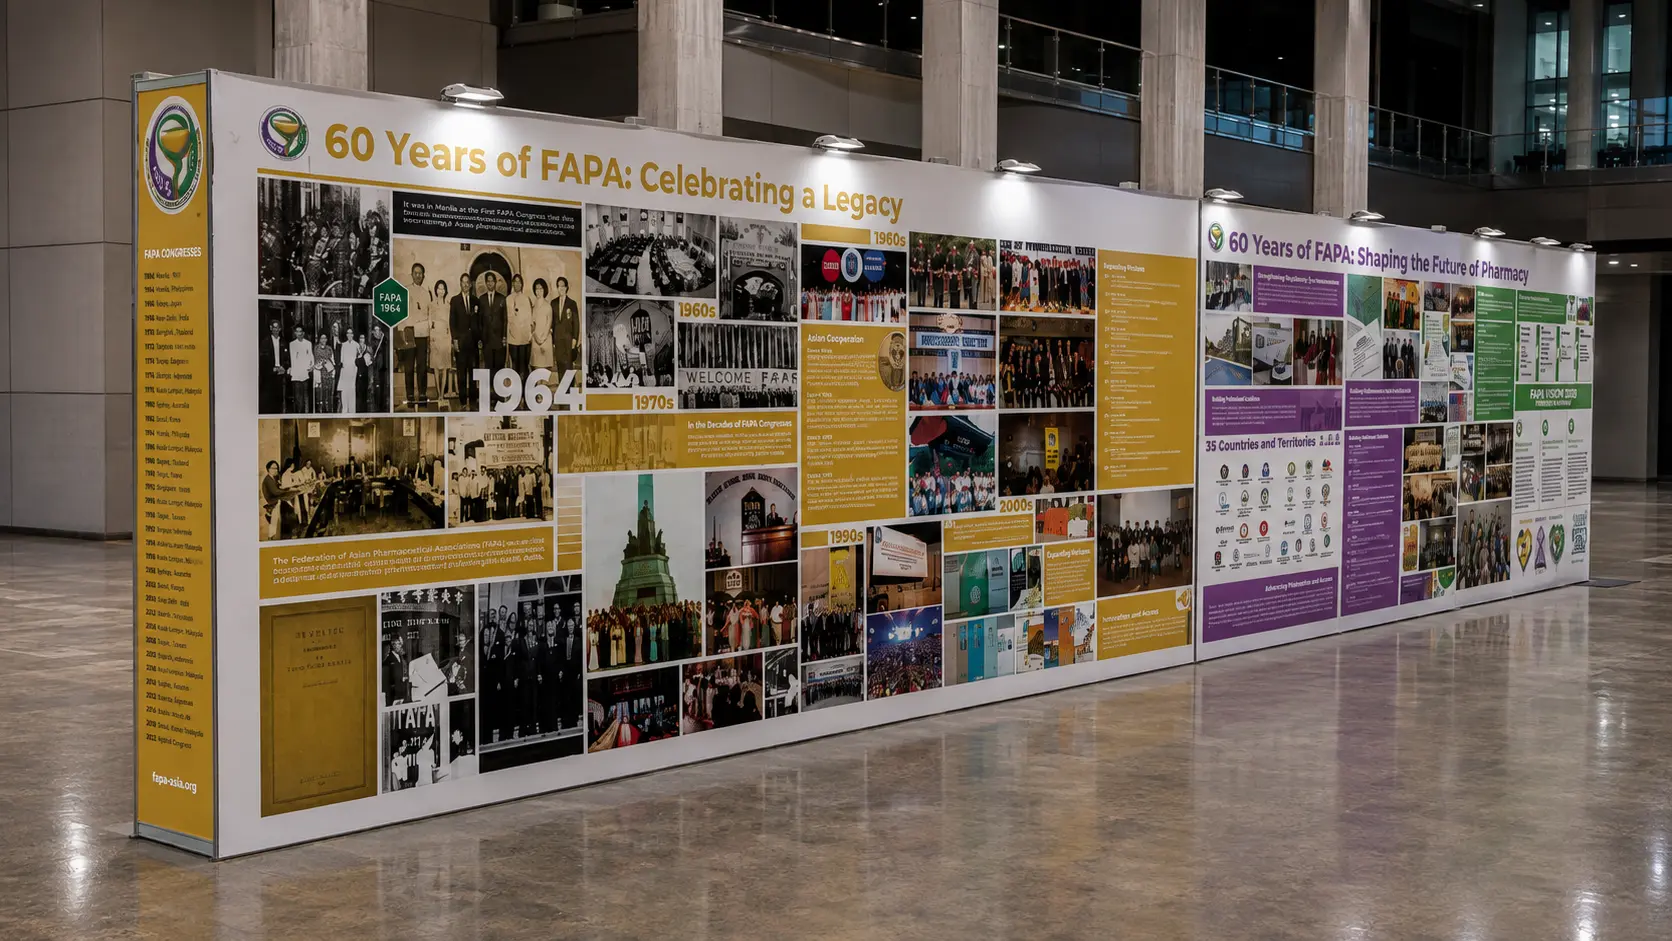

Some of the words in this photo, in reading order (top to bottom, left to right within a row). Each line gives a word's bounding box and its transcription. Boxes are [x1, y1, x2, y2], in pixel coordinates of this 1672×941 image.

[325, 123, 375, 162] 60
[385, 130, 486, 174] Years
[496, 145, 531, 179] of
[541, 149, 632, 190] FAPA:
[640, 161, 794, 214] Celebrating
[802, 187, 816, 210] a
[823, 184, 904, 225] Legacy
[873, 231, 906, 247] 1960s
[1229, 231, 1249, 254] 60
[1252, 234, 1293, 258] Years
[1297, 239, 1312, 260] of
[1315, 241, 1355, 265] FAPA:
[1357, 247, 1408, 275] Shaping
[1411, 252, 1430, 271] the
[1432, 255, 1467, 276] Future
[1469, 261, 1479, 278] of
[1481, 261, 1529, 286] Pharmacy
[379, 293, 401, 302] FAPA
[380, 304, 401, 312] 1964
[679, 302, 716, 318] 1960s
[686, 371, 752, 384] WELCOME
[473, 368, 583, 412] 1964
[635, 395, 674, 410] 1970s
[695, 421, 706, 429] the
[1206, 440, 1217, 452] 35
[1218, 438, 1259, 452] Countries
[1260, 438, 1276, 449] and
[1277, 435, 1316, 449] Territories
[999, 498, 1033, 513] 2000s
[830, 528, 864, 544] 1990s
[273, 557, 289, 565] The
[291, 553, 336, 564] Federation
[338, 552, 348, 560] of
[152, 771, 197, 794] fapa-asia.org
